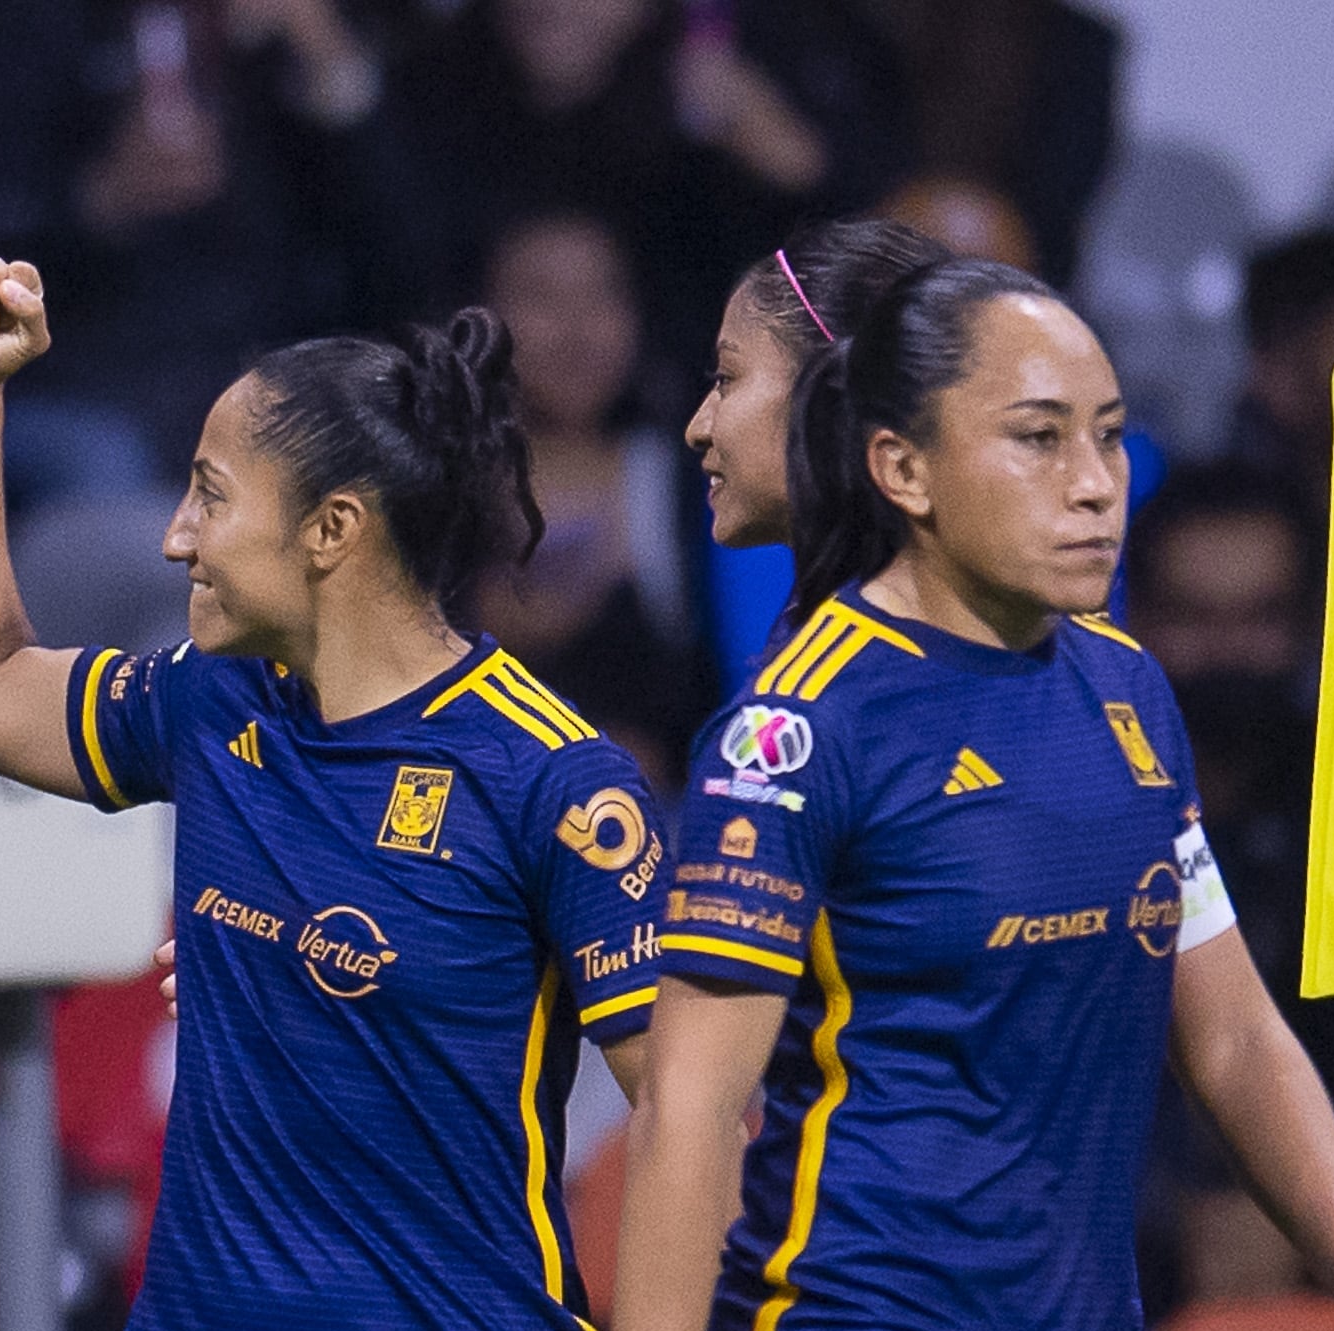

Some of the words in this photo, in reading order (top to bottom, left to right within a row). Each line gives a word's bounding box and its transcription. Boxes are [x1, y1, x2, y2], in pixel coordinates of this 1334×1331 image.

[211, 898, 286, 943] CEMEX
[296, 922, 382, 979] Vertua
[1022, 907, 1110, 944] CEMEX
[574, 939, 629, 982] Tim
